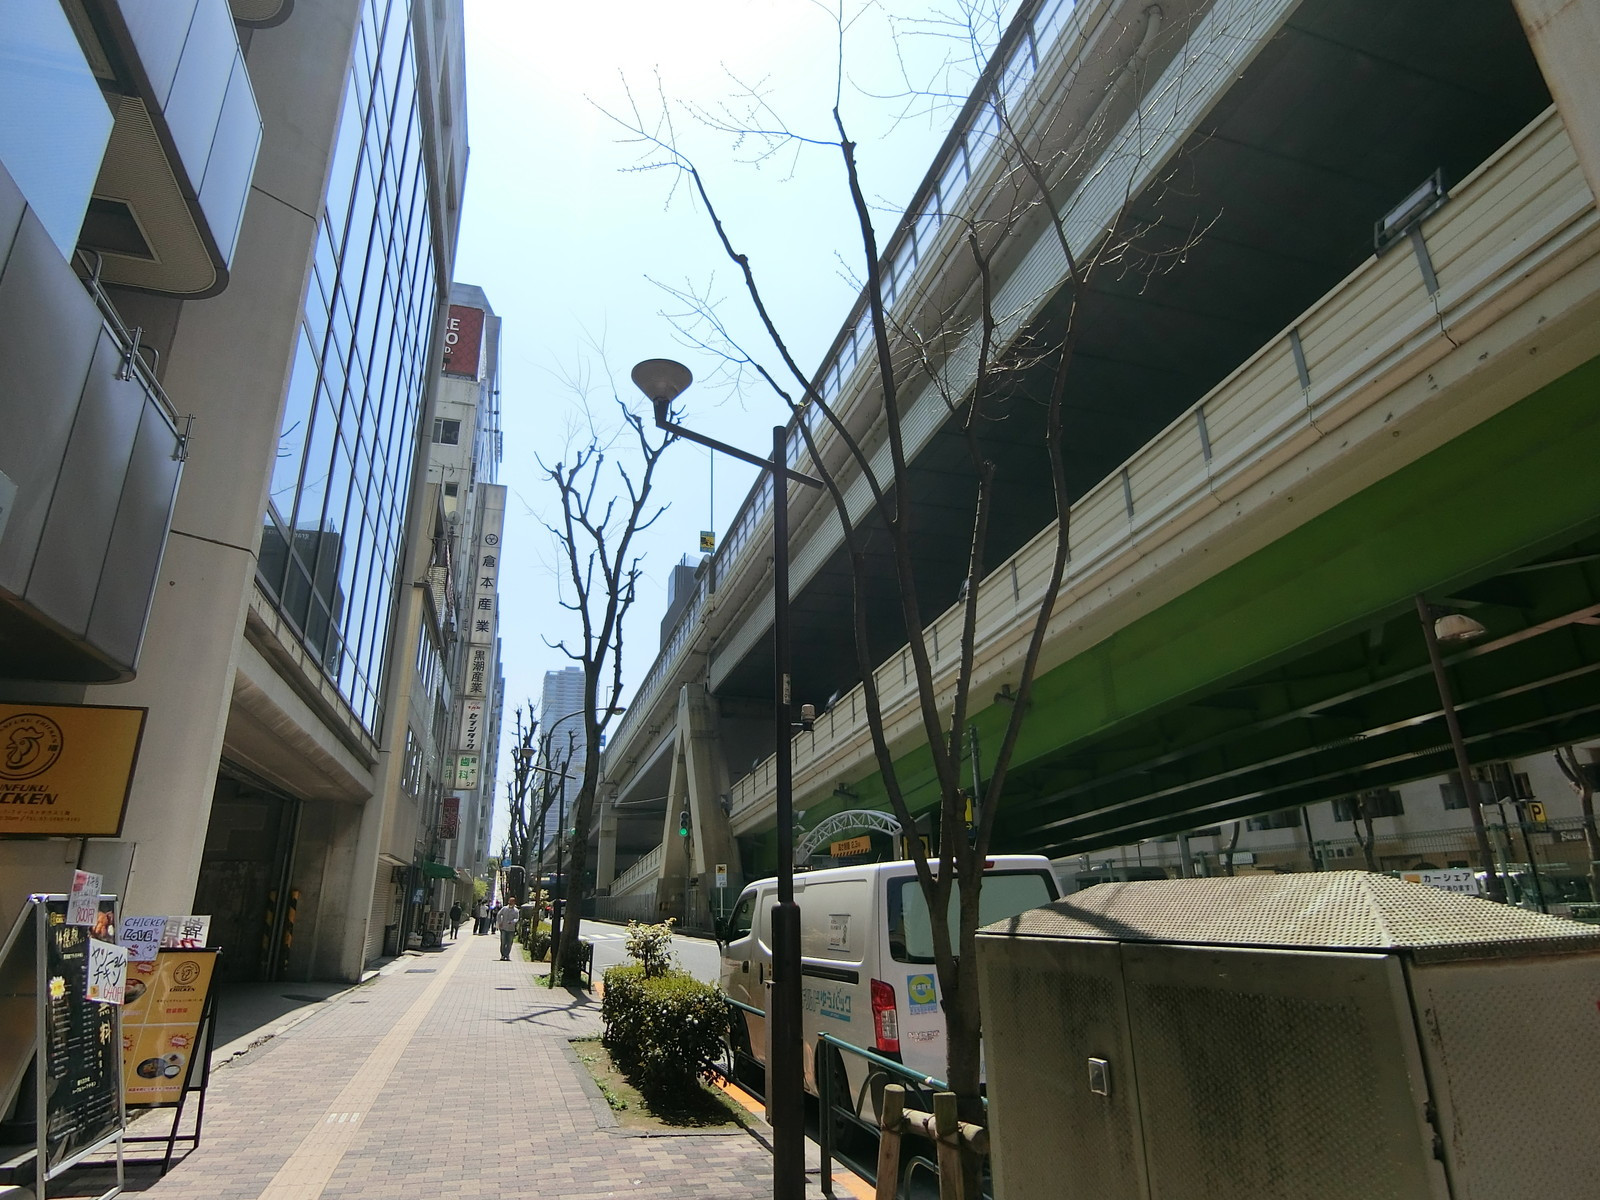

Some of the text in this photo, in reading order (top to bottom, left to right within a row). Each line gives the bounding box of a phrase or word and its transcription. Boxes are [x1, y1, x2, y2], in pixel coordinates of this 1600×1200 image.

[446, 318, 461, 331] E
[475, 554, 497, 633] 倉本産業
[470, 650, 485, 693] 黒潮産業
[459, 757, 470, 780] 歯科
[0, 784, 49, 792] NFUKU
[0, 793, 59, 804] CKEN
[1531, 804, 1542, 821] P
[1423, 872, 1471, 883] カーシェア
[125, 917, 167, 927] CHICKEN
[123, 928, 153, 942] LOVE
